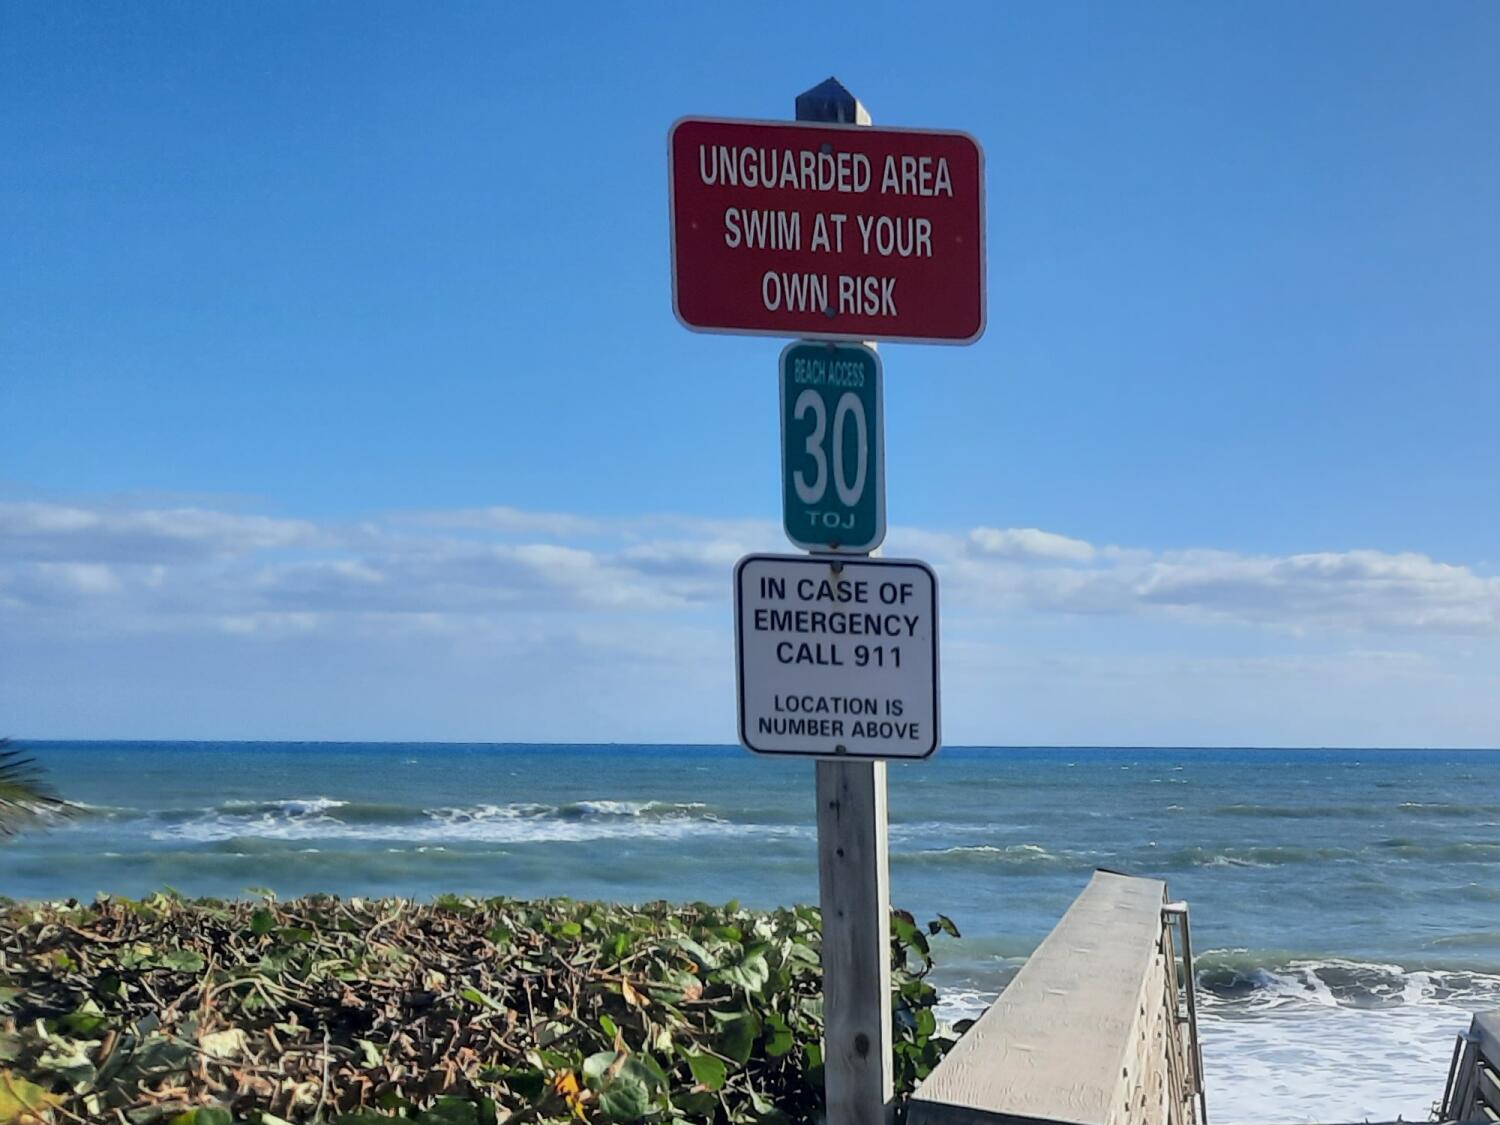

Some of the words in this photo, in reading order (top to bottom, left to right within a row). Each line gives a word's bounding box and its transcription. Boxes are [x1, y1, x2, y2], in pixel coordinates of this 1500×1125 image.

[700, 144, 872, 193] UNGUARDED
[881, 155, 953, 197] AREA
[724, 207, 800, 250] SWIM
[811, 213, 847, 253] AT
[857, 216, 932, 257] YOUR
[762, 271, 828, 313] OWN
[839, 276, 897, 316] RISK
[794, 358, 826, 384] BEACH
[828, 361, 865, 387] ACCESS
[793, 389, 868, 507] 30
[806, 511, 855, 529] TOJ
[760, 577, 786, 600] IN
[797, 578, 868, 604] CASE
[879, 582, 914, 605] OF
[754, 609, 919, 638] EMERGENCY
[776, 642, 844, 667] CALL
[854, 645, 902, 668] 911
[774, 695, 881, 716] LOCATION
[886, 698, 904, 717] IS
[759, 718, 844, 737] NUMBER
[851, 721, 920, 740] ABOVE
